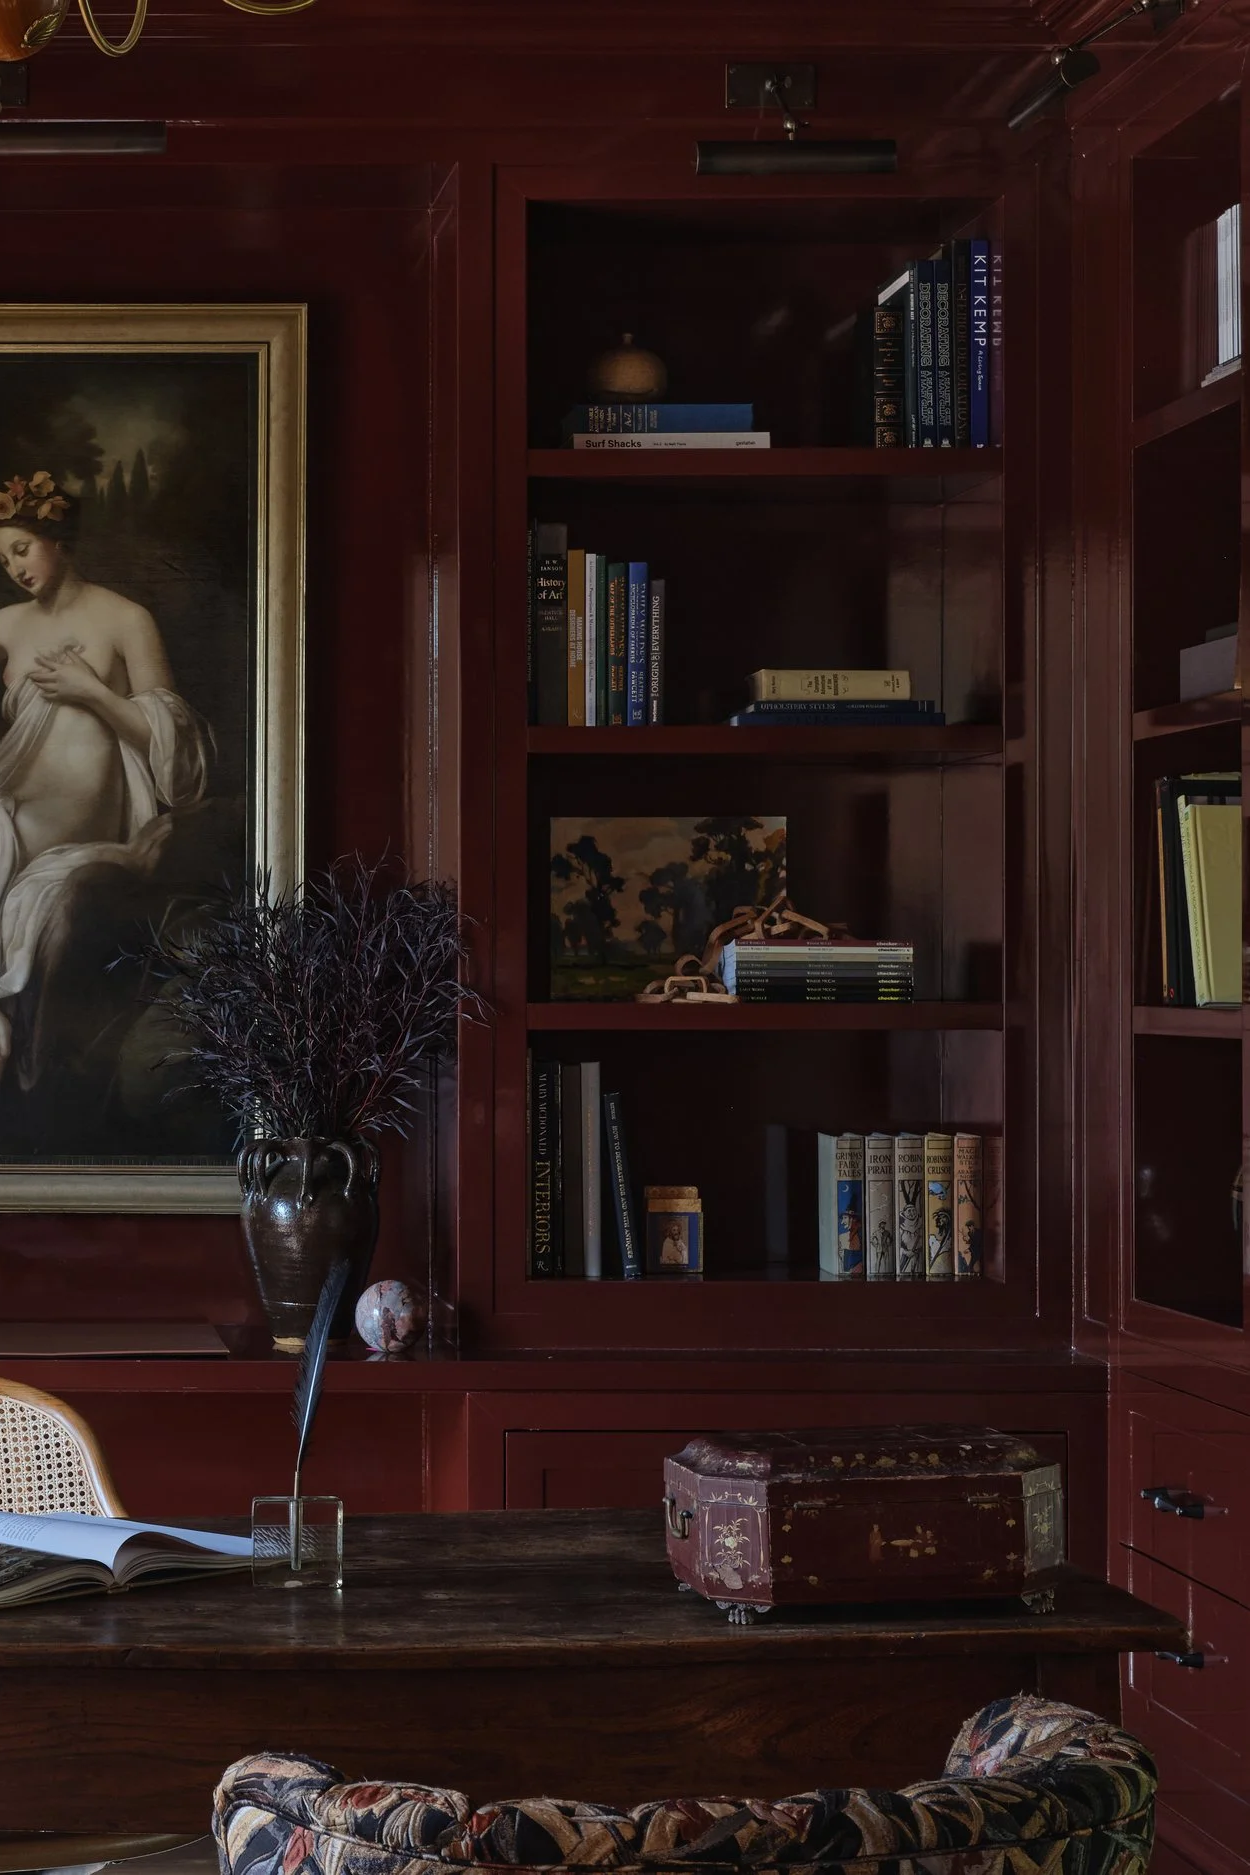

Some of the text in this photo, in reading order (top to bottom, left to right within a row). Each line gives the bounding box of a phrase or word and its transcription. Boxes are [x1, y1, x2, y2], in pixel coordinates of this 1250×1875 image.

[973, 254, 987, 347] KIT KEMP
[956, 282, 967, 342] INTERIOR
[918, 282, 933, 367] DECORATING
[937, 282, 951, 367] DECORATING
[585, 439, 642, 448] Surf Shacks
[536, 577, 565, 591] History
[536, 589, 564, 600] of Art
[651, 595, 660, 651] EVERYTHING
[651, 661, 660, 693] ORIGIN
[760, 703, 808, 711] UPHOLSTERY
[808, 703, 837, 711] STYLES
[537, 1071, 548, 1155] MARY MCDONALD
[611, 1125, 620, 1141] HOW
[613, 1141, 621, 1151] TO
[835, 1152, 863, 1161] GRIMM'S
[869, 1154, 891, 1163] IRON
[898, 1154, 922, 1163] ROBIN
[926, 1155, 951, 1164] ROBINSO
[614, 1151, 624, 1183] DECORATE
[838, 1161, 860, 1169] FAIRY
[867, 1165, 893, 1175] PIRATE
[898, 1165, 922, 1174] HOOD
[838, 1169, 861, 1178] TALES
[618, 1184, 626, 1196] FOR
[534, 1159, 551, 1253] INTERIORS
[620, 1197, 628, 1210] AND
[622, 1211, 630, 1228] WITH
[624, 1229, 634, 1259] ANTIQUES
